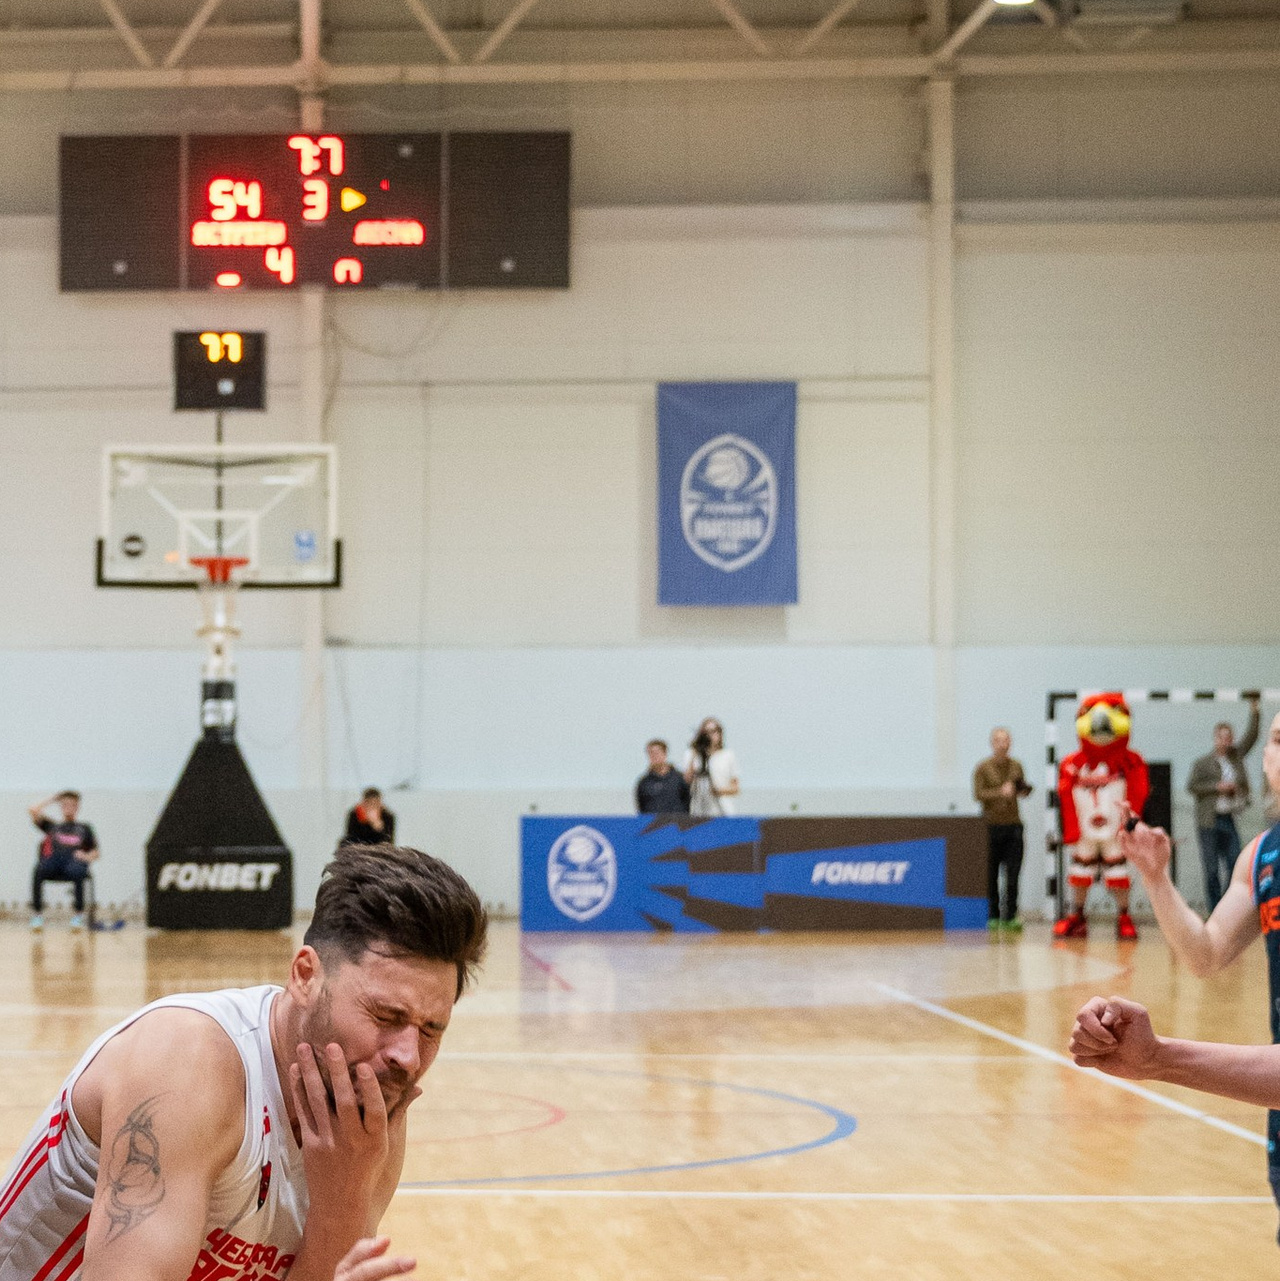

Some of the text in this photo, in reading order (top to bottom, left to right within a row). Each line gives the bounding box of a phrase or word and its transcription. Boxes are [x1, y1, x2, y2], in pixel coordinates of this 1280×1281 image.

[207, 177, 263, 221] 54
[301, 178, 331, 221] 3
[264, 245, 296, 284] 4
[156, 861, 282, 892] FONBET
[810, 859, 910, 886] FONBET
